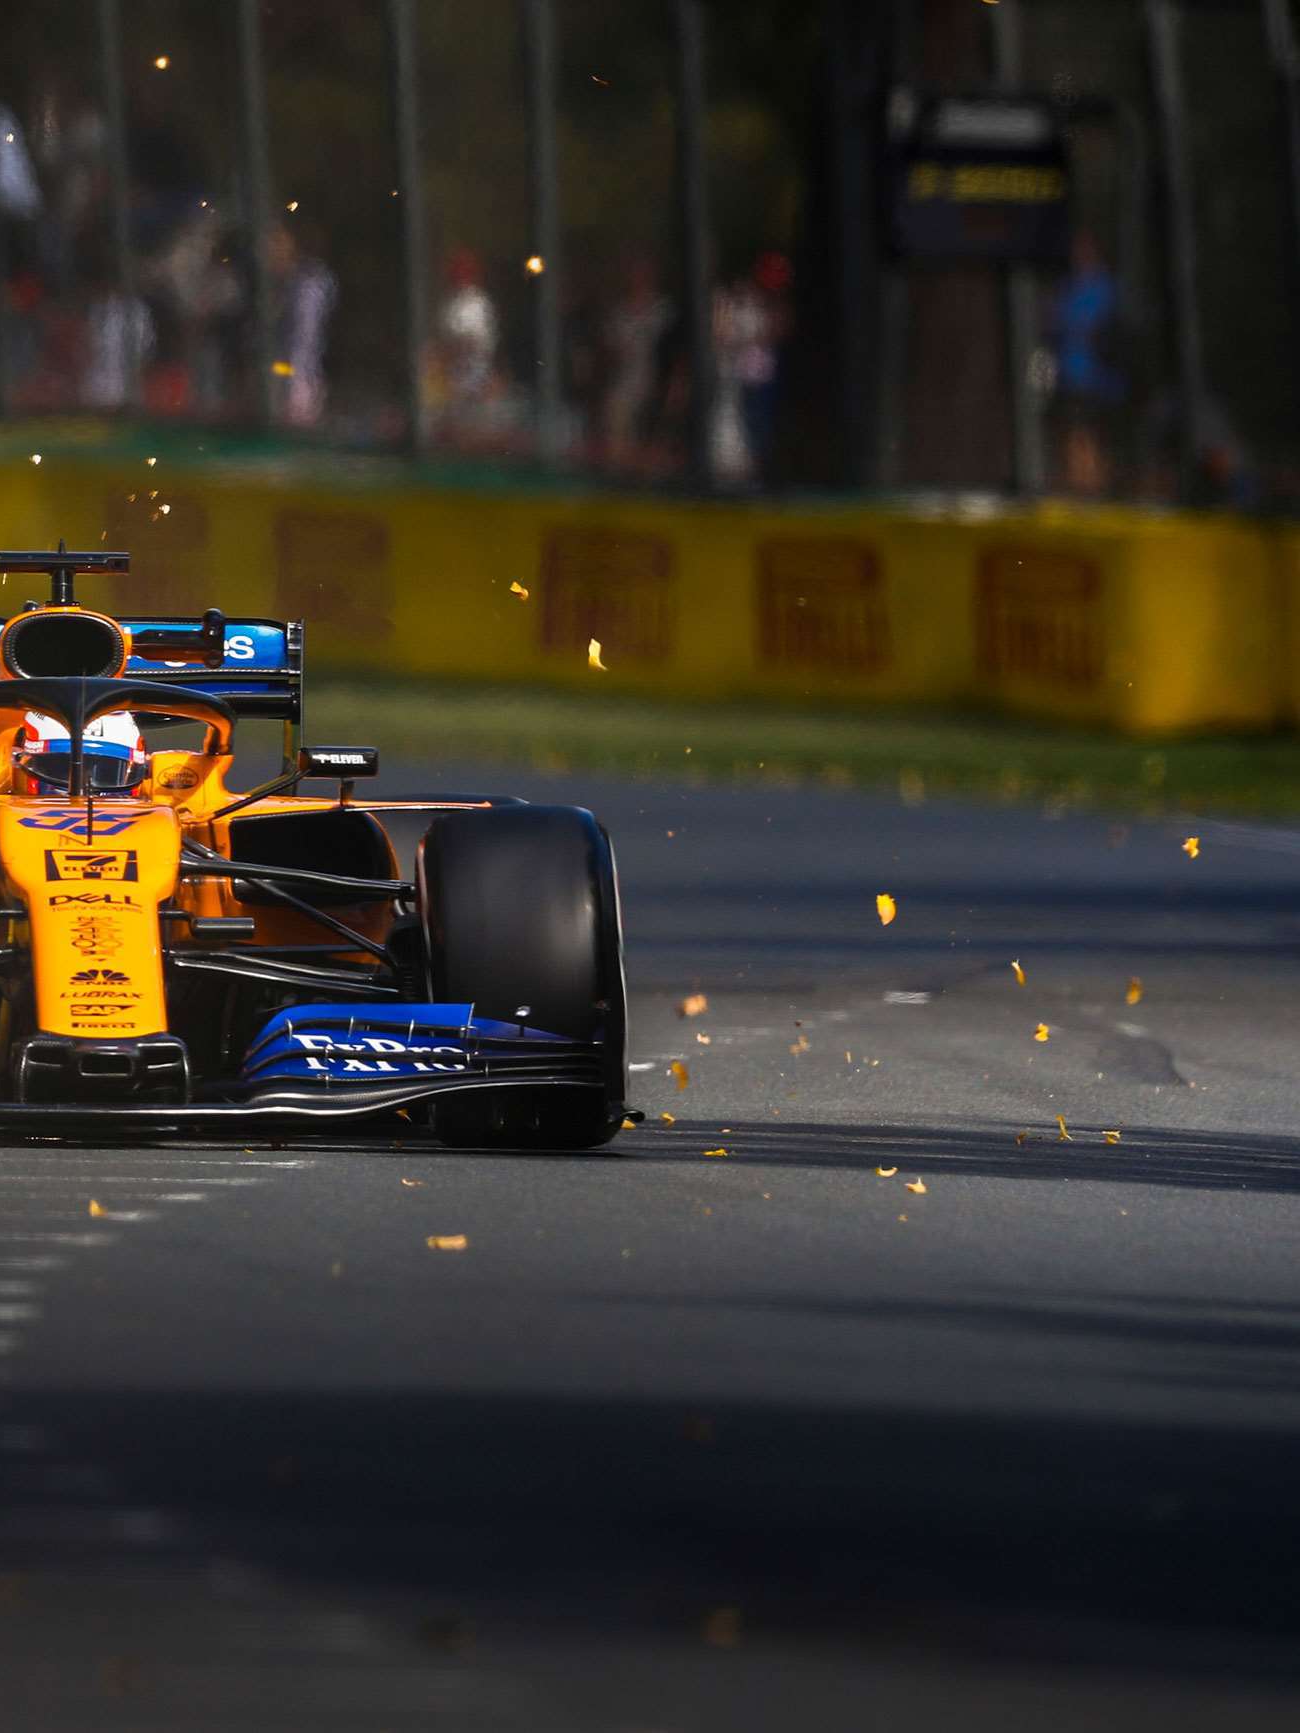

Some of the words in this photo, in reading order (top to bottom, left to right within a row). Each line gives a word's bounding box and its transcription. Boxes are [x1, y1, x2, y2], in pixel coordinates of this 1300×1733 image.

[65, 855, 117, 879] 7
[49, 893, 143, 906] DELL
[71, 1005, 122, 1016] SAP
